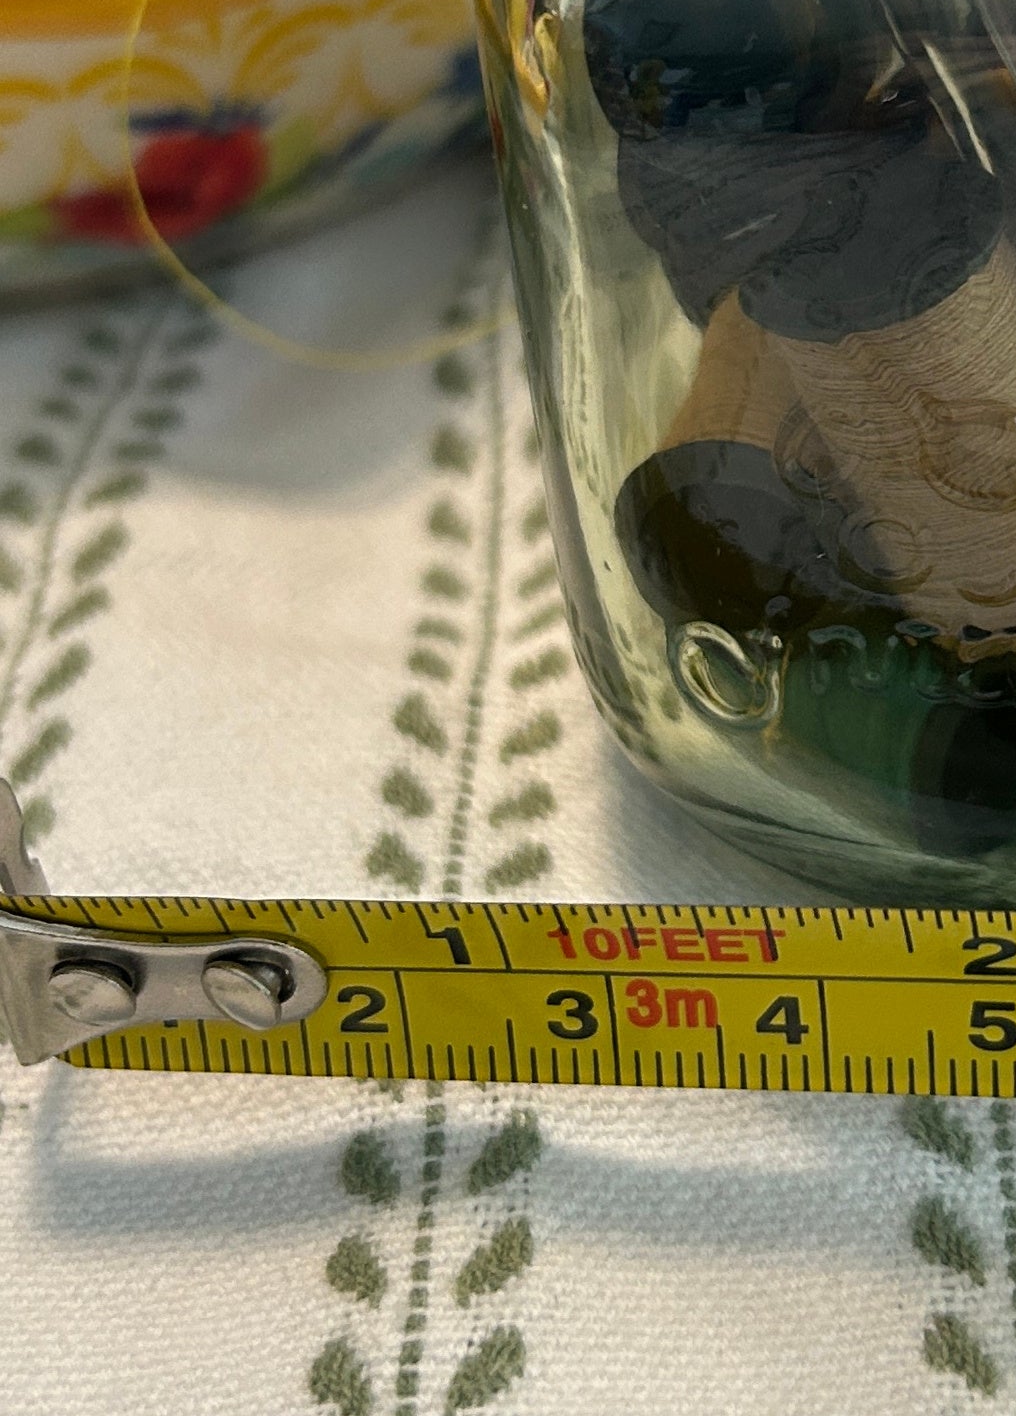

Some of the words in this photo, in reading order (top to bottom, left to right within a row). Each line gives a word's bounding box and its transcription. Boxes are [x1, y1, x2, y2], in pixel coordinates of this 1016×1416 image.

[425, 925, 471, 965] 1
[547, 926, 786, 963] 10FEET
[336, 985, 389, 1033] 2
[546, 989, 599, 1040] 3
[624, 978, 718, 1028] 3m
[755, 995, 809, 1044] 4
